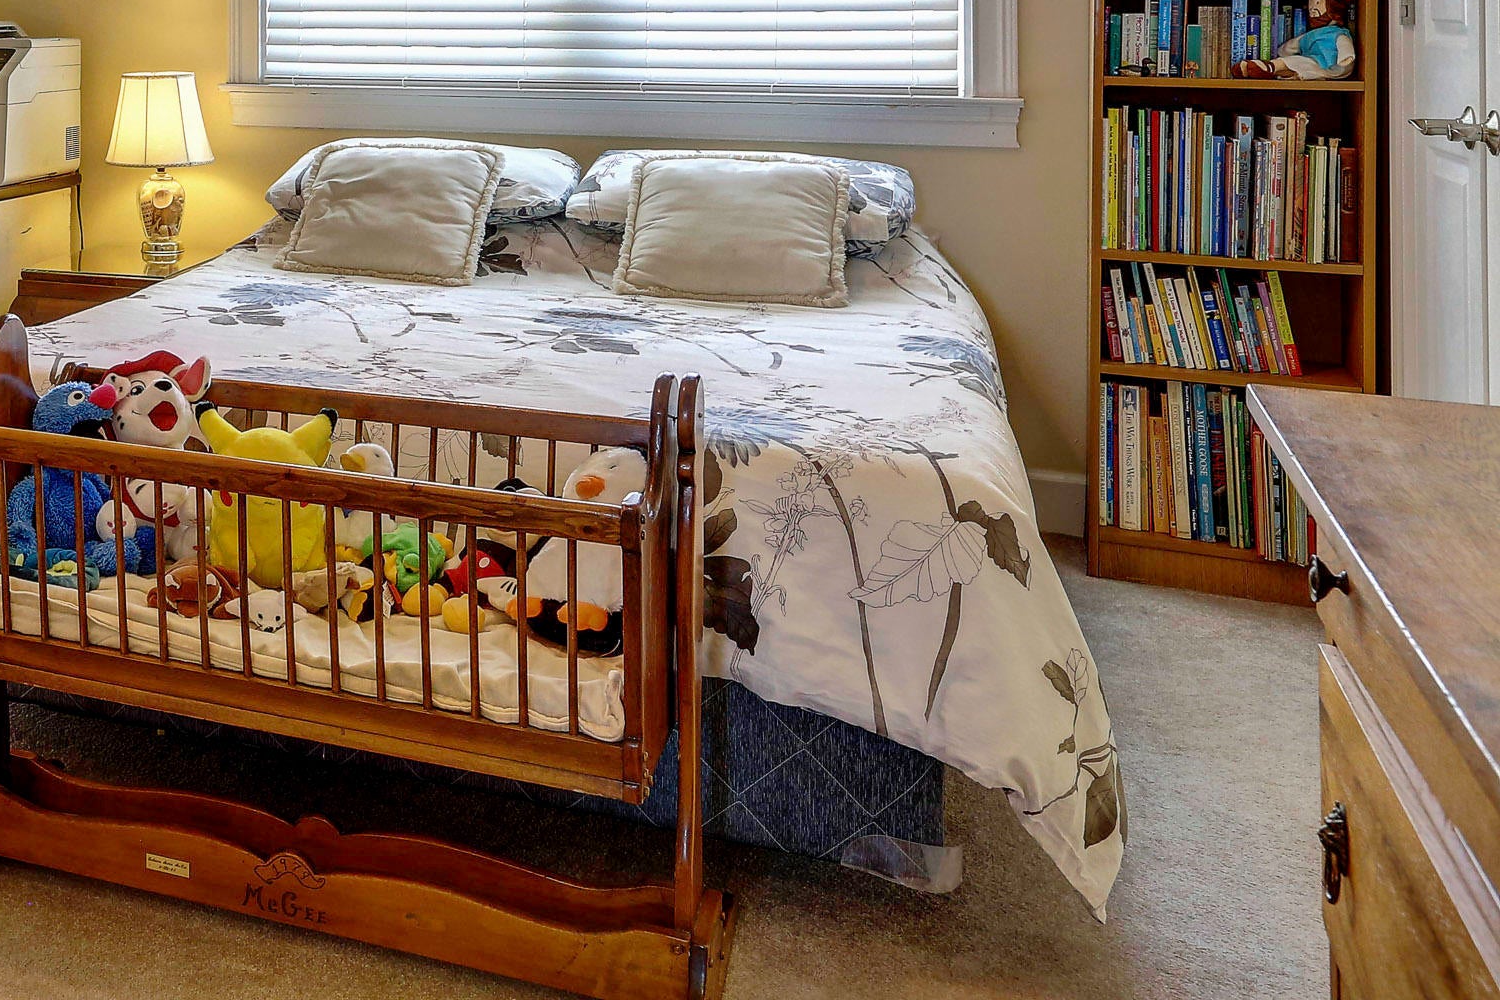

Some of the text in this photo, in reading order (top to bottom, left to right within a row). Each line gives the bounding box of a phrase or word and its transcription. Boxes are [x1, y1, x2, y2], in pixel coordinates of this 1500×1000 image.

[1135, 16, 1143, 35] FROSTY
[1196, 409, 1207, 447] MOTHER
[1125, 411, 1135, 488] THE WAY THINGS WORK
[1198, 448, 1208, 476] GOOSE
[271, 858, 310, 880] 1979
